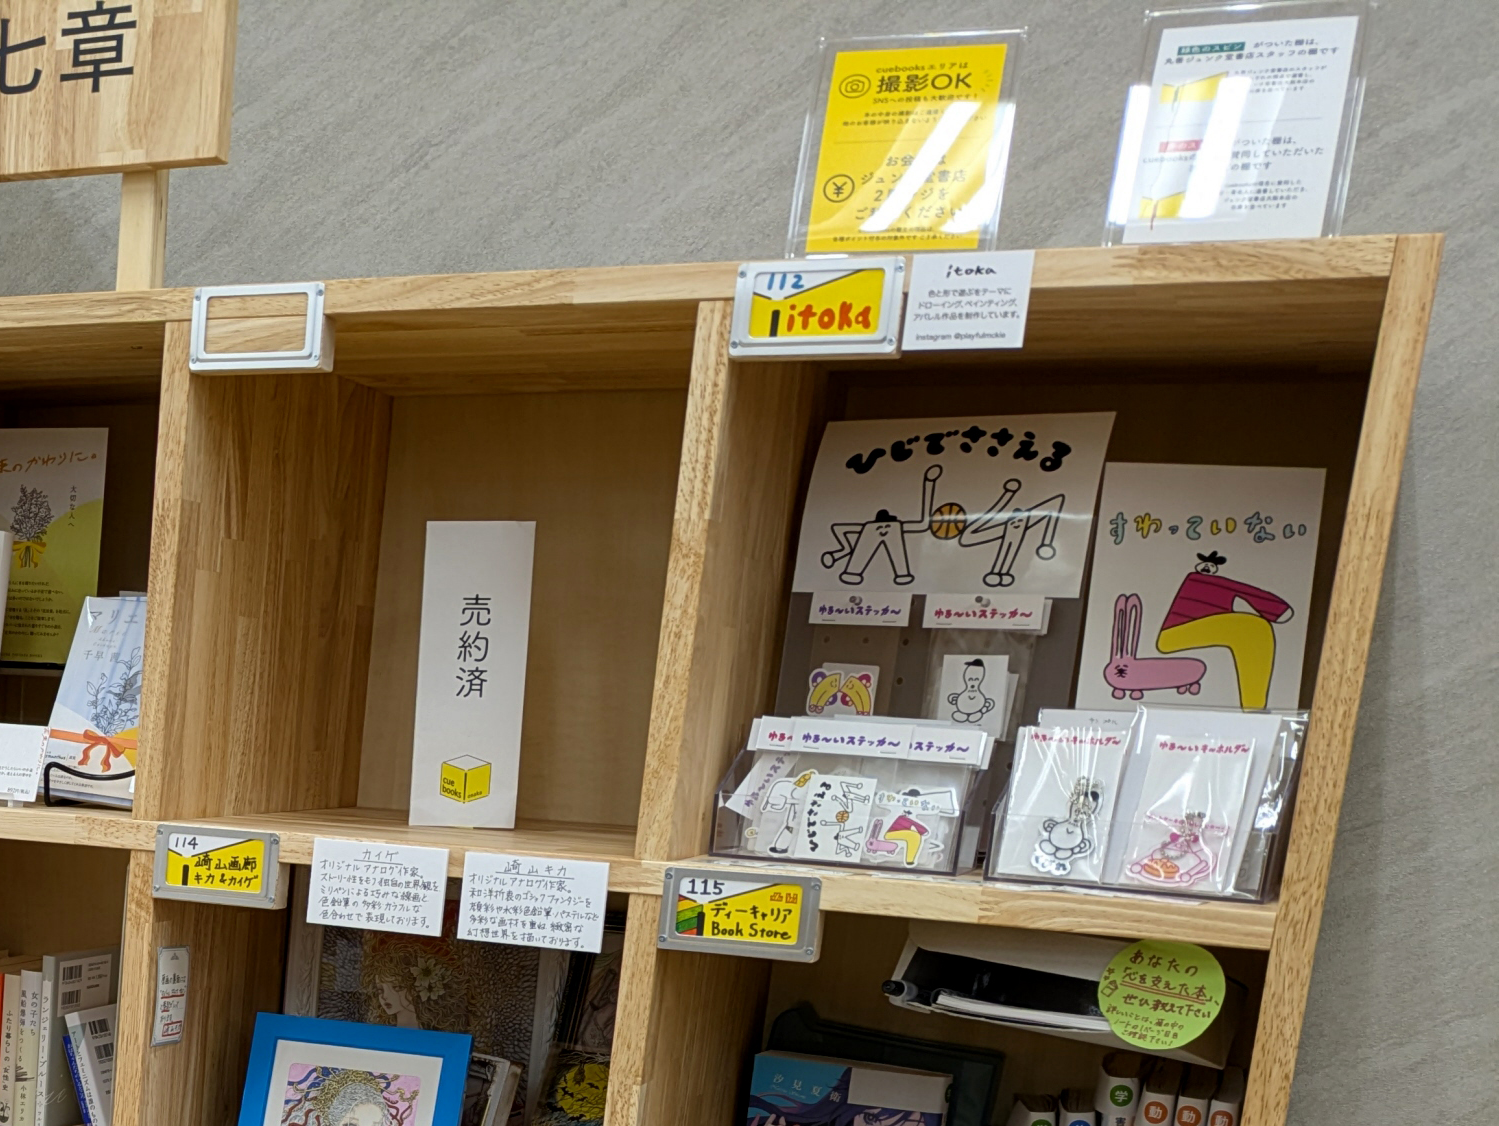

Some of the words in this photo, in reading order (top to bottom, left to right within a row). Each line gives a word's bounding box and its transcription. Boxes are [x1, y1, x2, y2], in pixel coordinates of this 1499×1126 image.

[876, 72, 972, 94] 撮影OK
[767, 273, 805, 290] 112
[946, 264, 997, 279] itoka
[927, 287, 1012, 299] 色と形で遊ぶをテーマに
[918, 298, 1018, 310] ドローイング、ペインティング、
[786, 301, 872, 332] itoka
[913, 309, 1021, 321] アパレル作品を制作しています。
[846, 426, 1072, 474] ひじでささえる
[1110, 512, 1307, 545] すわっていない
[87, 607, 138, 626] マリエ
[455, 594, 492, 698] 売約済
[442, 778, 455, 786] cue
[442, 784, 462, 799] books
[174, 836, 198, 851] 114
[362, 849, 399, 861] カイゲ
[686, 878, 723, 896] 115
[710, 902, 793, 923] ディーキャリア
[711, 922, 743, 938] Book
[749, 924, 792, 942] Store
[1129, 949, 1198, 977] あなたの
[29, 991, 39, 1037] 女の子たち
[1122, 993, 1211, 1018] ぜひ教えて下さい
[18, 989, 27, 1063] 風船爆弾をつくる
[39, 995, 50, 1097] ランジェリー・ブルース
